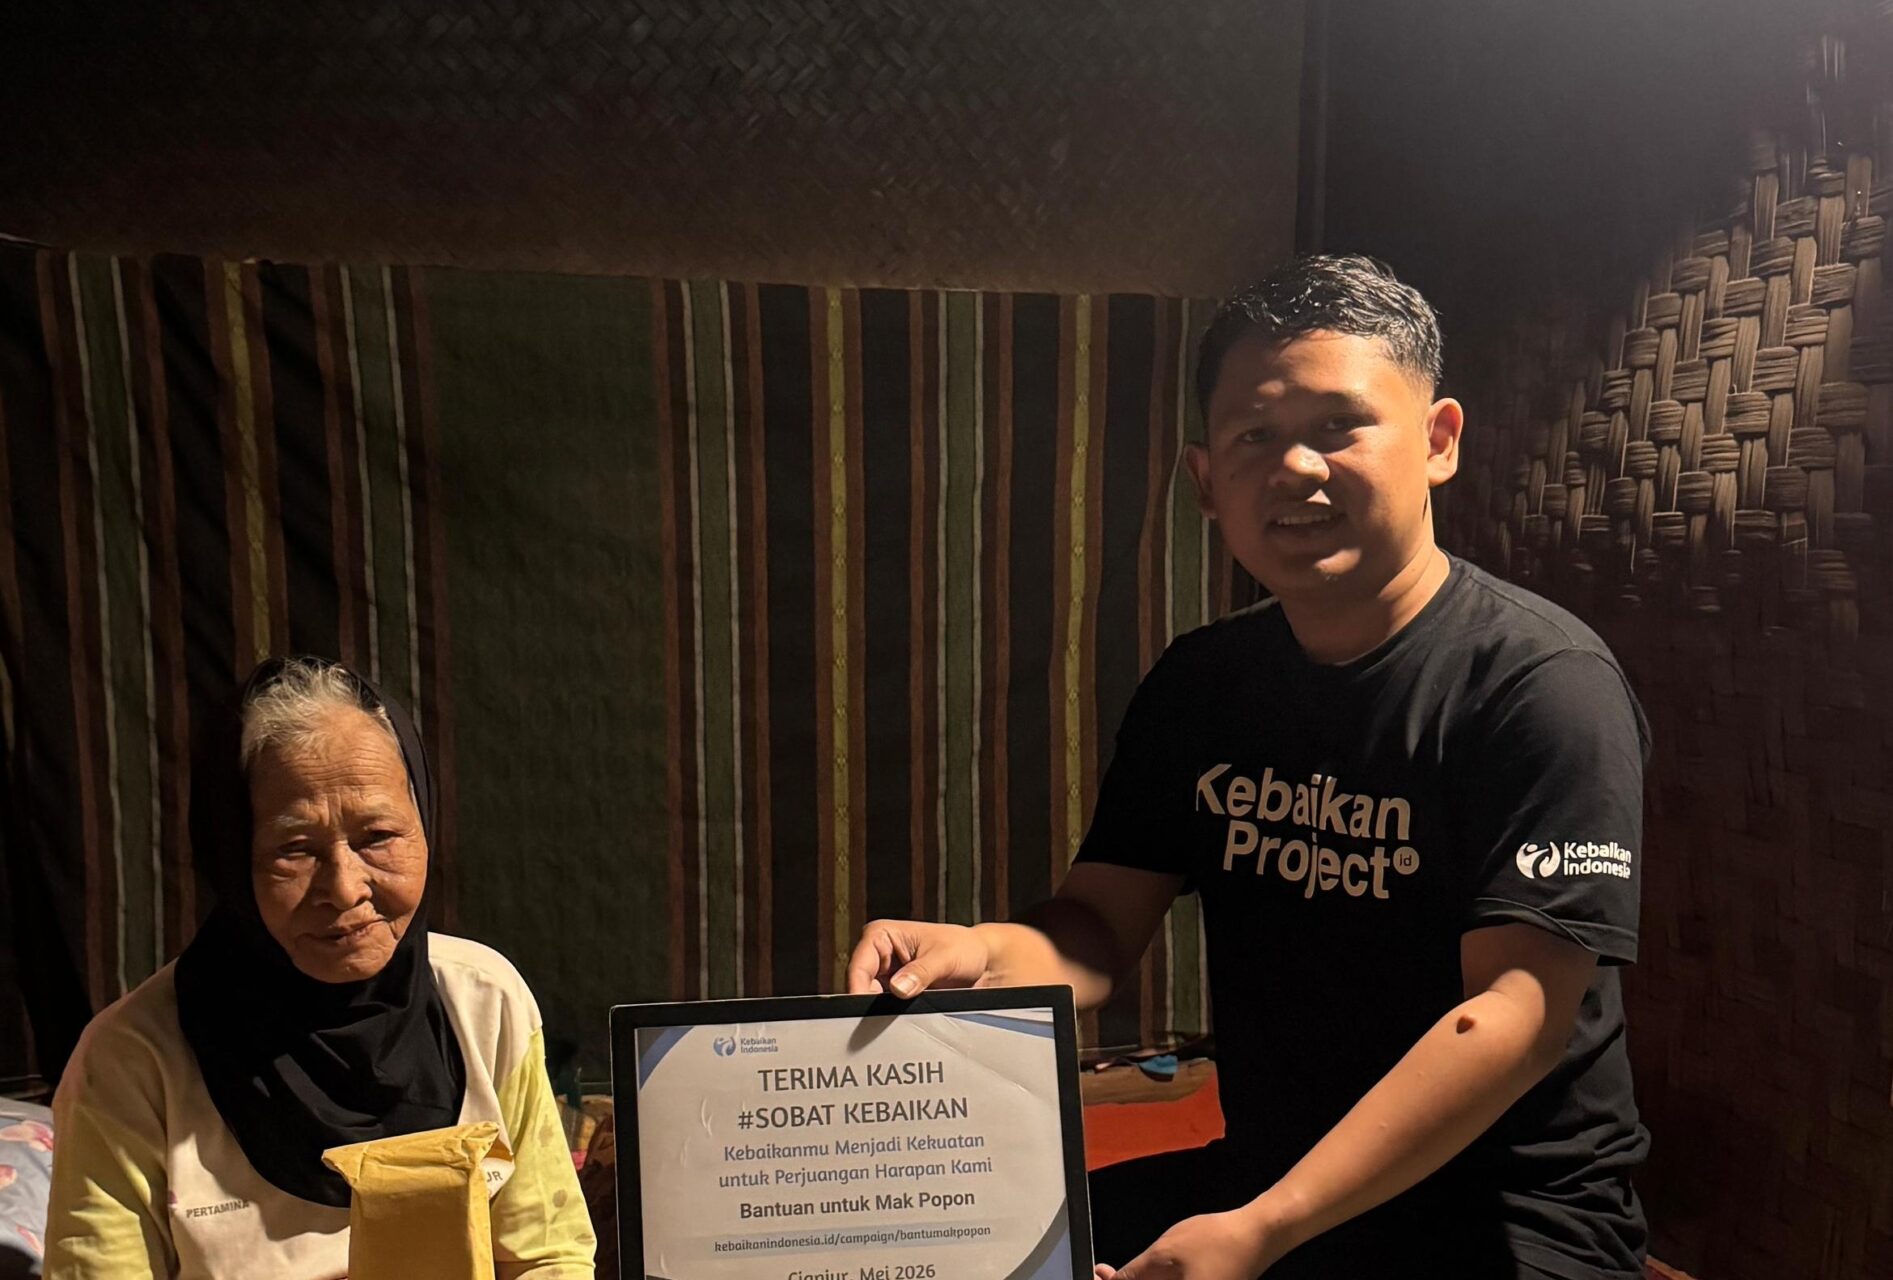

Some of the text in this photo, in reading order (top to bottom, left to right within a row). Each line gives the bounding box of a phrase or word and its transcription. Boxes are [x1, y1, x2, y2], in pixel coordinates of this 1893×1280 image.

[1196, 763, 1410, 840] Kebaikan
[1223, 820, 1391, 899] Project
[1563, 842, 1632, 863] Kebaikan
[1563, 860, 1631, 879] Indonesia
[740, 1036, 778, 1047] Kebaikan
[740, 1044, 779, 1054] Indonesia
[758, 1061, 945, 1093] TERIMA KASIH
[738, 1097, 969, 1130] #SOBAT KEBAIKAN
[724, 1133, 985, 1161] Kebaikanmu Menjadi Kekuatan
[718, 1157, 992, 1189] untuk Perjuangan Harapan Kami
[186, 1200, 250, 1218] PERTAMINA
[740, 1191, 976, 1219] Bantuan untuk Mak Popon
[714, 1225, 991, 1253] kebaikanindonesia.id/campaign/bantumakpopon
